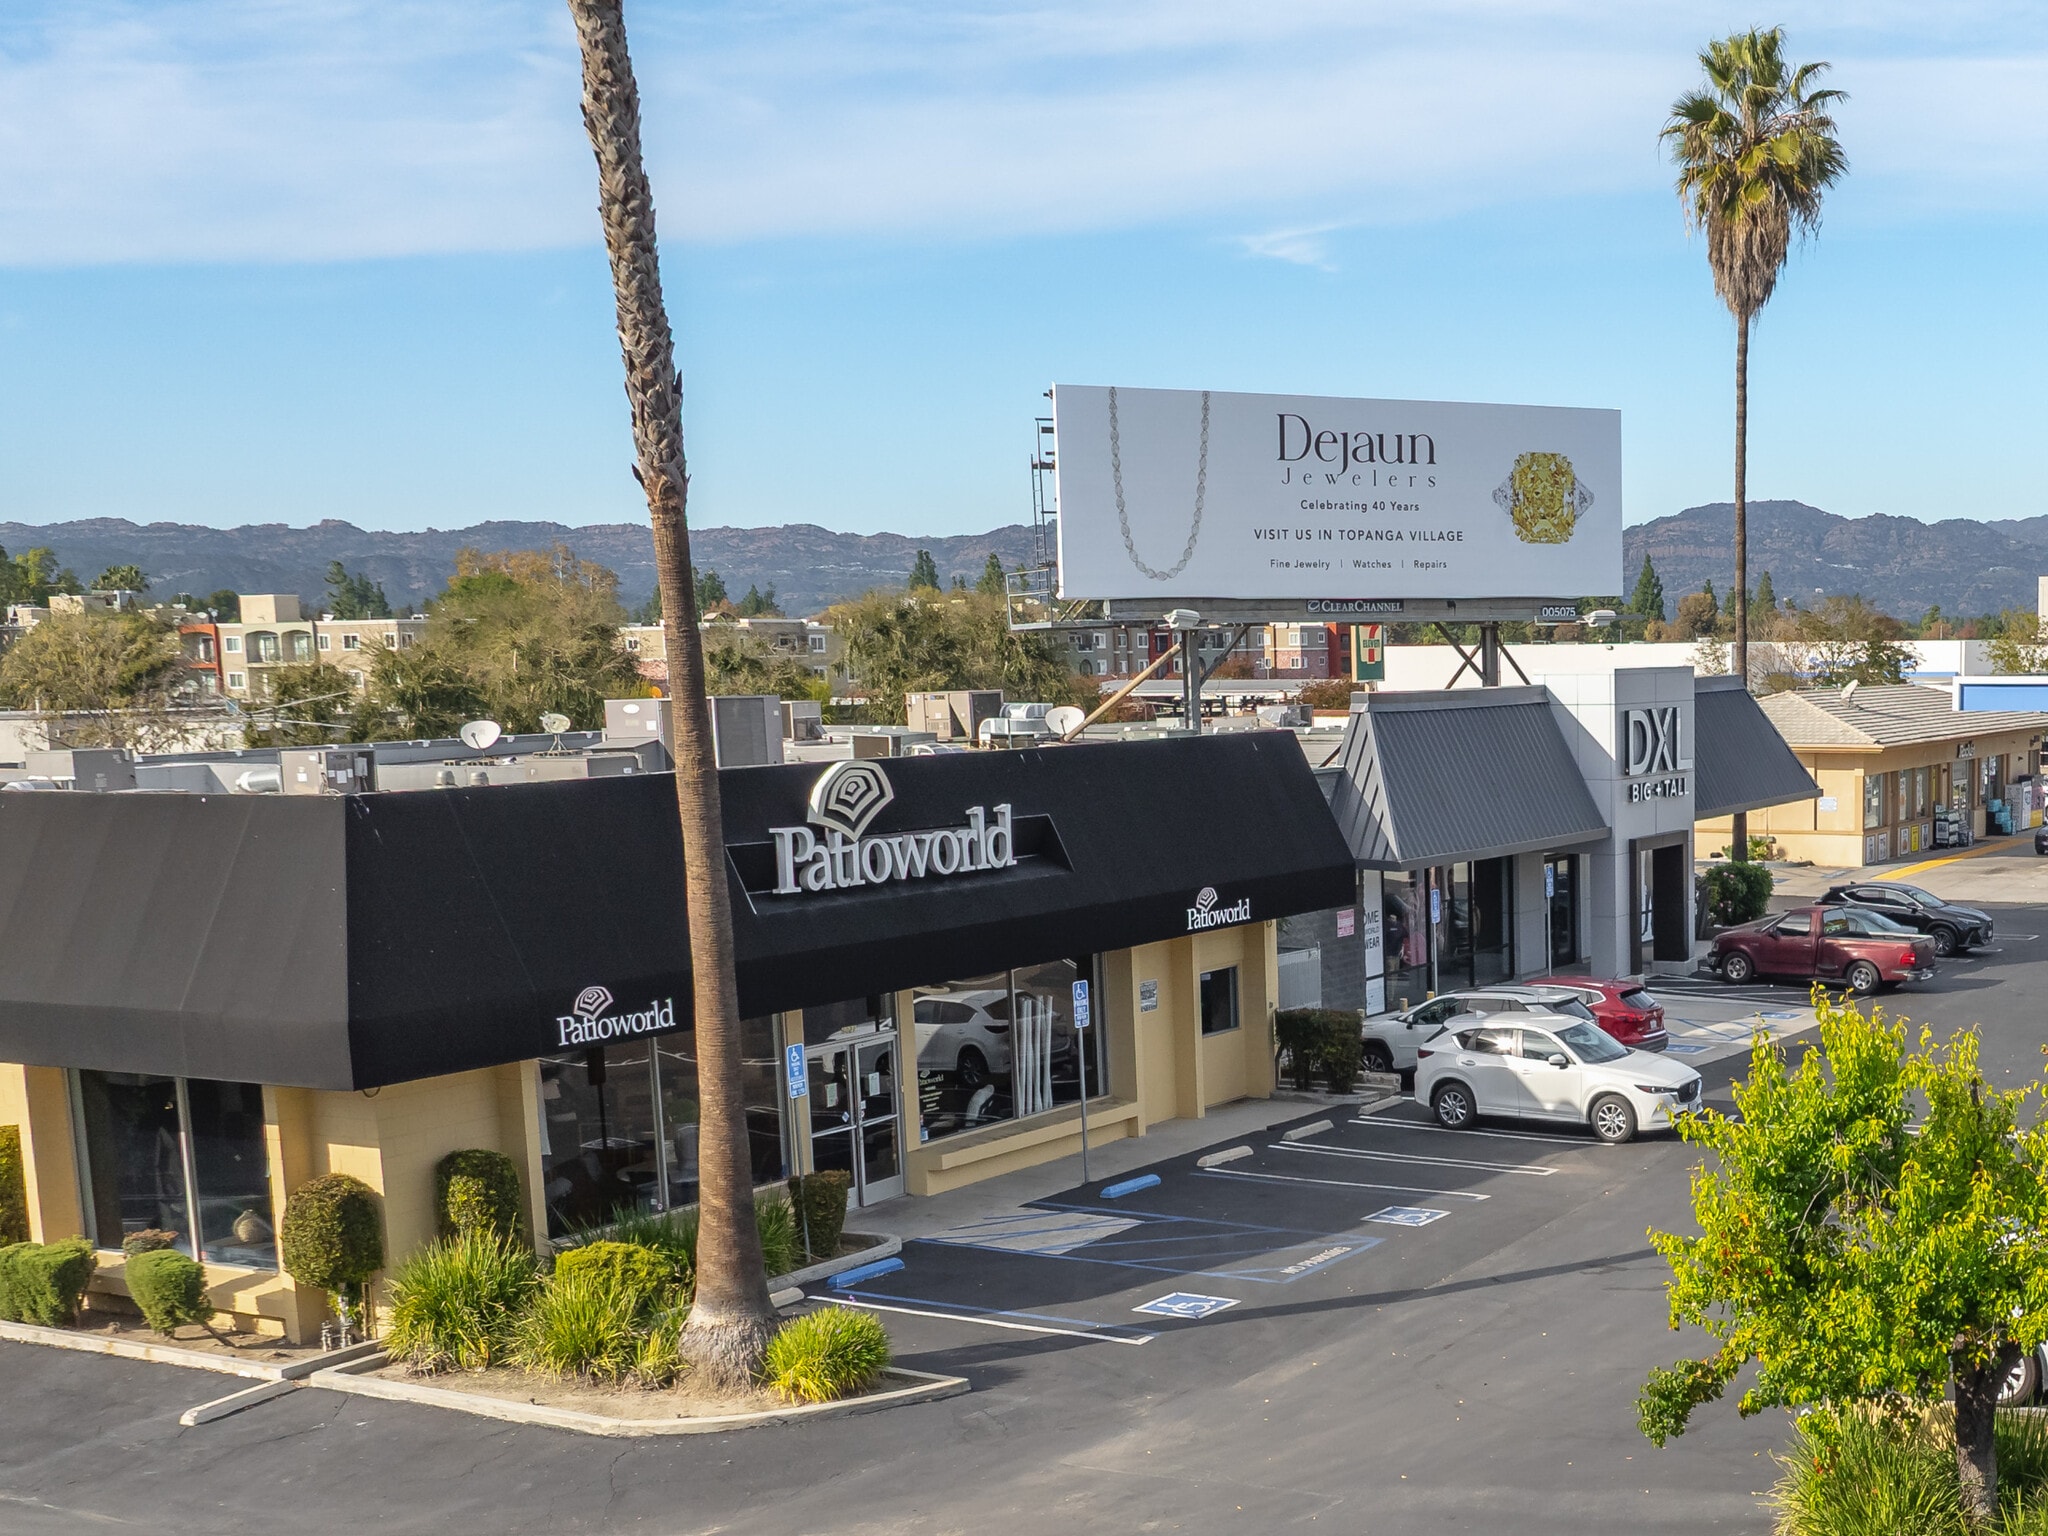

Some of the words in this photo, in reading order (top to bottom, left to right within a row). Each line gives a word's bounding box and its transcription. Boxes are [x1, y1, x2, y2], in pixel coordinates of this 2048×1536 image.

[1276, 413, 1437, 476] Dejaun
[1281, 467, 1436, 488] Jewelers
[1300, 500, 1368, 513] Celebrating
[1372, 501, 1386, 511] 40
[1390, 501, 1420, 512] Years
[1254, 529, 1289, 540] VISIT
[1295, 529, 1312, 541] US
[1318, 529, 1332, 541] IN
[1338, 530, 1404, 541] TOPANGA
[1409, 530, 1464, 542] VILLAGE
[1270, 559, 1290, 569] Fine
[1294, 559, 1330, 571] Jewelry
[1352, 559, 1392, 569] Watches
[1413, 560, 1447, 571] Repairs
[1542, 606, 1576, 617] 005075
[1625, 707, 1693, 776] DXL
[1631, 782, 1651, 803] BIG
[1664, 778, 1690, 798] TALL
[768, 803, 1018, 894] Patioworld
[1187, 898, 1251, 931] Patioworld
[557, 997, 676, 1047] Patioworld
